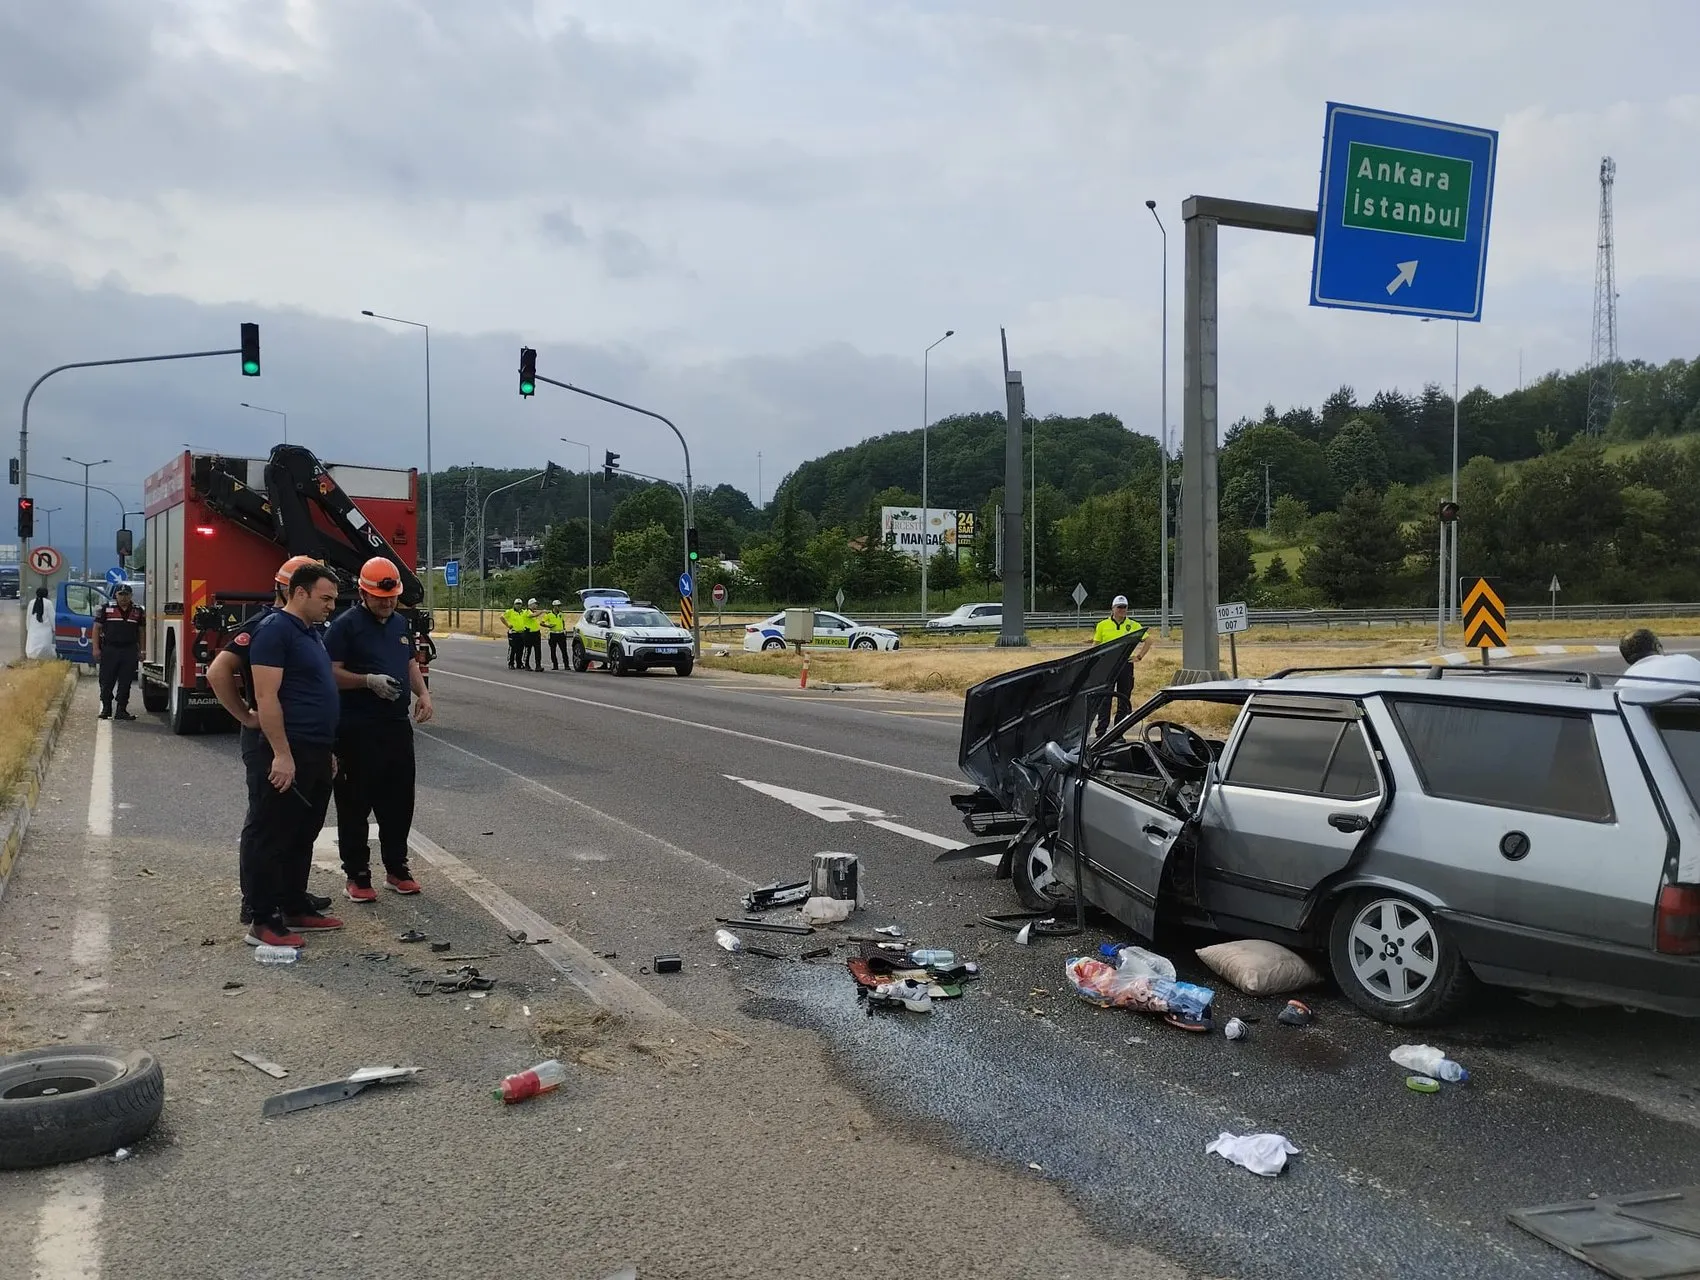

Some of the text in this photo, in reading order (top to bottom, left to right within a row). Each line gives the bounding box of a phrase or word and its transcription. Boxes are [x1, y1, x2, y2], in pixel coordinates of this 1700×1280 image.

[1357, 157, 1449, 190] Ankara
[1353, 188, 1460, 228] İstanbul
[958, 512, 974, 526] 24
[958, 526, 974, 534] SAAT
[1218, 608, 1230, 617] 100
[1235, 606, 1244, 615] 12
[1225, 620, 1237, 630] 007
